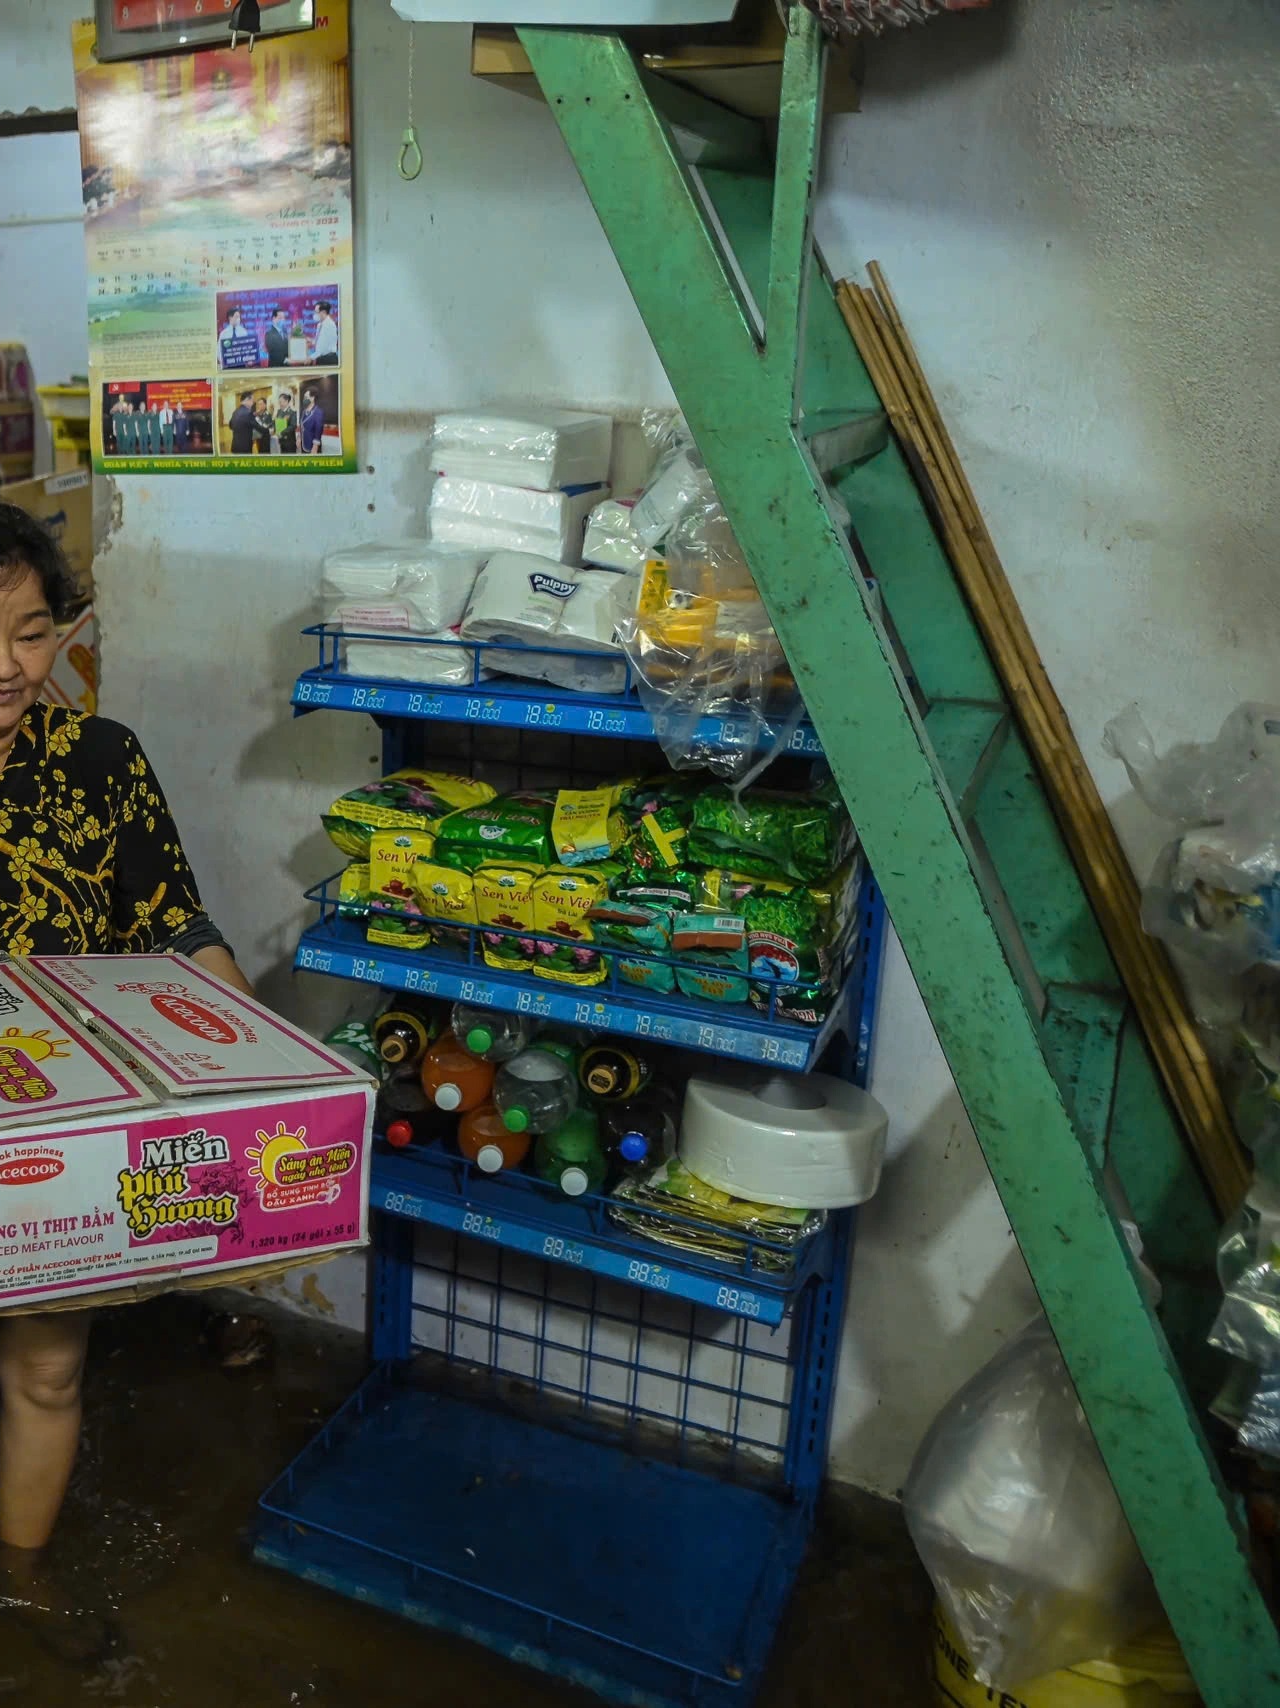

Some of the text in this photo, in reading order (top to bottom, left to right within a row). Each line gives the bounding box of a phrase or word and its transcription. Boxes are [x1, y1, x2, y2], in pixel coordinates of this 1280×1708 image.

[122, 8, 129, 19] 8
[195, 2, 203, 13] 6
[316, 217, 339, 226] 2022
[288, 261, 297, 270] 21
[308, 259, 316, 268] 22
[282, 457, 309, 468] PHÁT
[533, 574, 576, 594] Pulppy
[377, 849, 402, 864] Sen
[482, 886, 532, 906] Sen Việ
[541, 891, 594, 913] Sen Việt
[182, 991, 258, 1044] Cook happiness
[14, 1145, 64, 1158] happiness
[142, 1132, 227, 1169] Miến
[279, 1146, 351, 1172] Sáng ăn Miến
[281, 1173, 307, 1184] ngày
[309, 1167, 326, 1178] nhẹ
[118, 1166, 187, 1212] Phú
[280, 1187, 301, 1197] SUNG
[303, 1184, 319, 1193] TINH
[289, 1193, 315, 1204] XANH
[127, 1195, 235, 1236] Hương
[22, 1221, 38, 1239] VỊ
[42, 1216, 78, 1236] THỊT
[21, 1241, 51, 1254] MEAT
[54, 1233, 104, 1249] FLAVOUR
[278, 1234, 288, 1245] kg
[42, 1259, 81, 1270] ACECOOK
[83, 1253, 102, 1264] VIỆT
[104, 1252, 122, 1260] NAM
